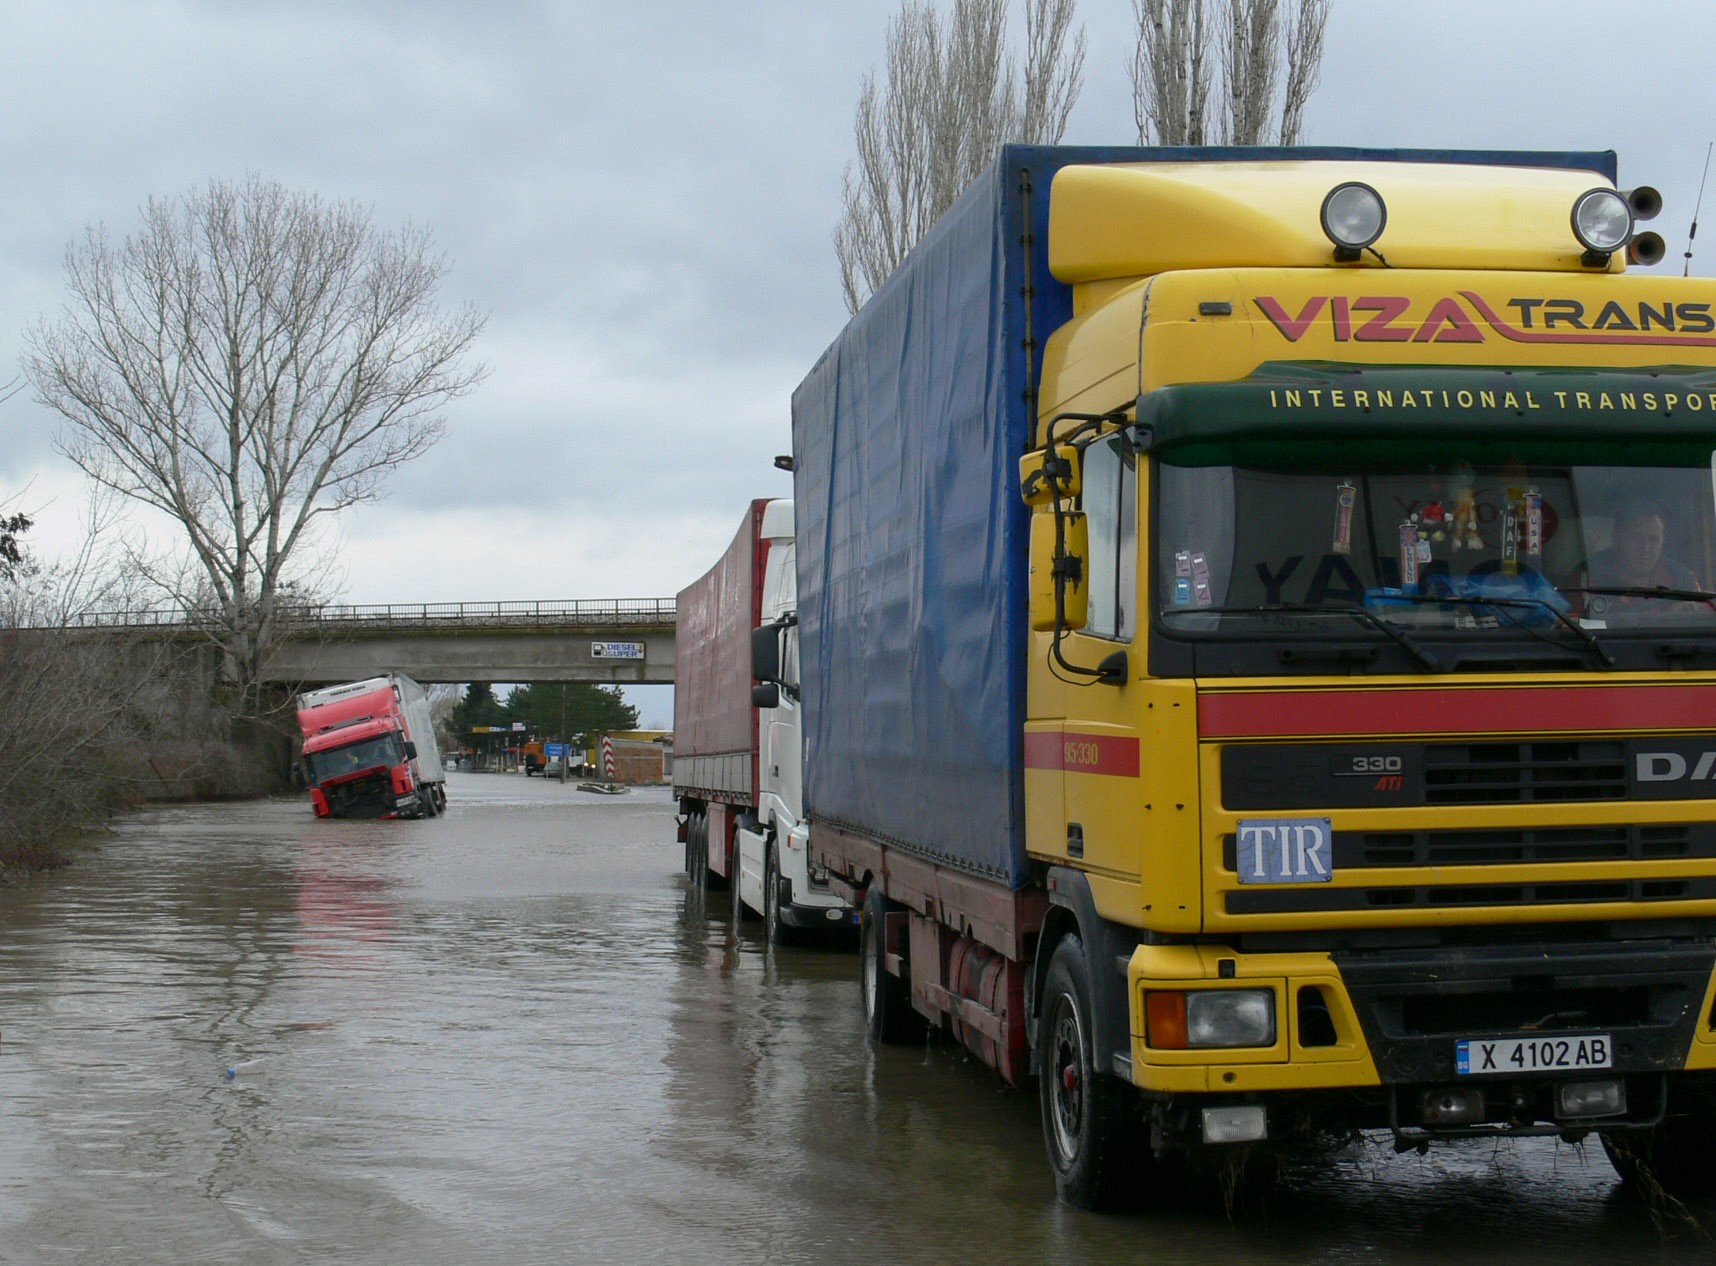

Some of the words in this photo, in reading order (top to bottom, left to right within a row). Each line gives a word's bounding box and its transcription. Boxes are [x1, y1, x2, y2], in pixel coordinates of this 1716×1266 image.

[1253, 296, 1487, 343] VIZA
[1506, 298, 1716, 333] TRANS
[1270, 389, 1541, 410] INTERNATIONAL
[1505, 515, 1515, 558] DAF
[1530, 516, 1539, 550] USA
[1352, 756, 1402, 772] 330
[1241, 825, 1327, 876] TIR
[1457, 1060, 1469, 1070] BG
[1481, 1044, 1496, 1069] X
[1510, 1041, 1569, 1068] 4102
[1575, 1039, 1606, 1065] AB
